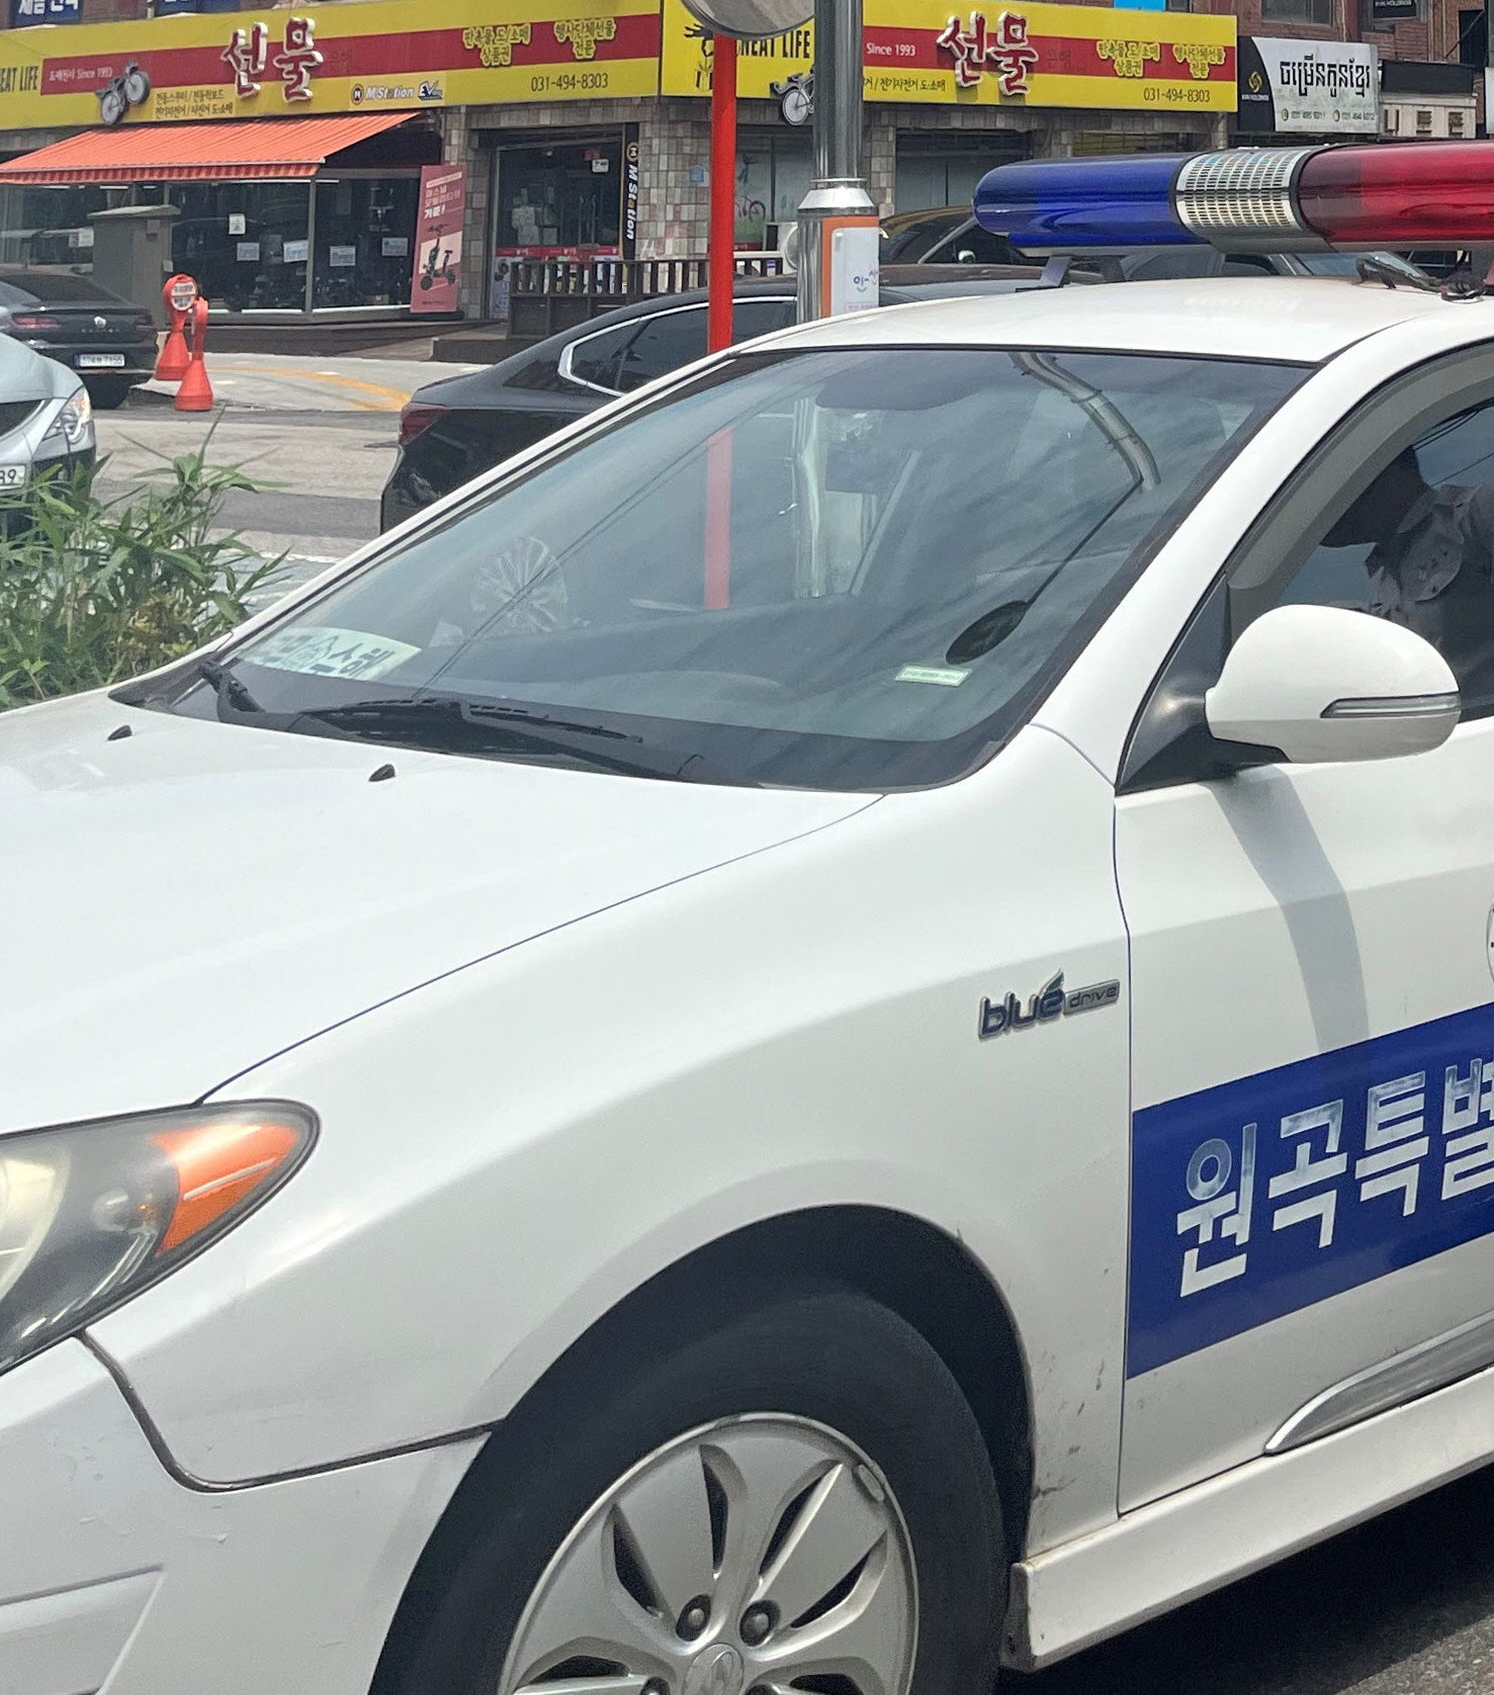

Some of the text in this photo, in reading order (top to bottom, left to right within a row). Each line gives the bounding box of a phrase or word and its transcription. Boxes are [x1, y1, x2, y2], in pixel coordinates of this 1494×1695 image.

[782, 30, 811, 59] LIFE
[866, 43, 916, 56] Since 1993
[937, 11, 1040, 95] 선물
[219, 16, 324, 104] 선물
[19, 65, 39, 92] LIFE
[530, 72, 609, 92] 031-494-8303
[1143, 87, 1211, 103] 031-494-8303
[978, 986, 1118, 1041] blue drive
